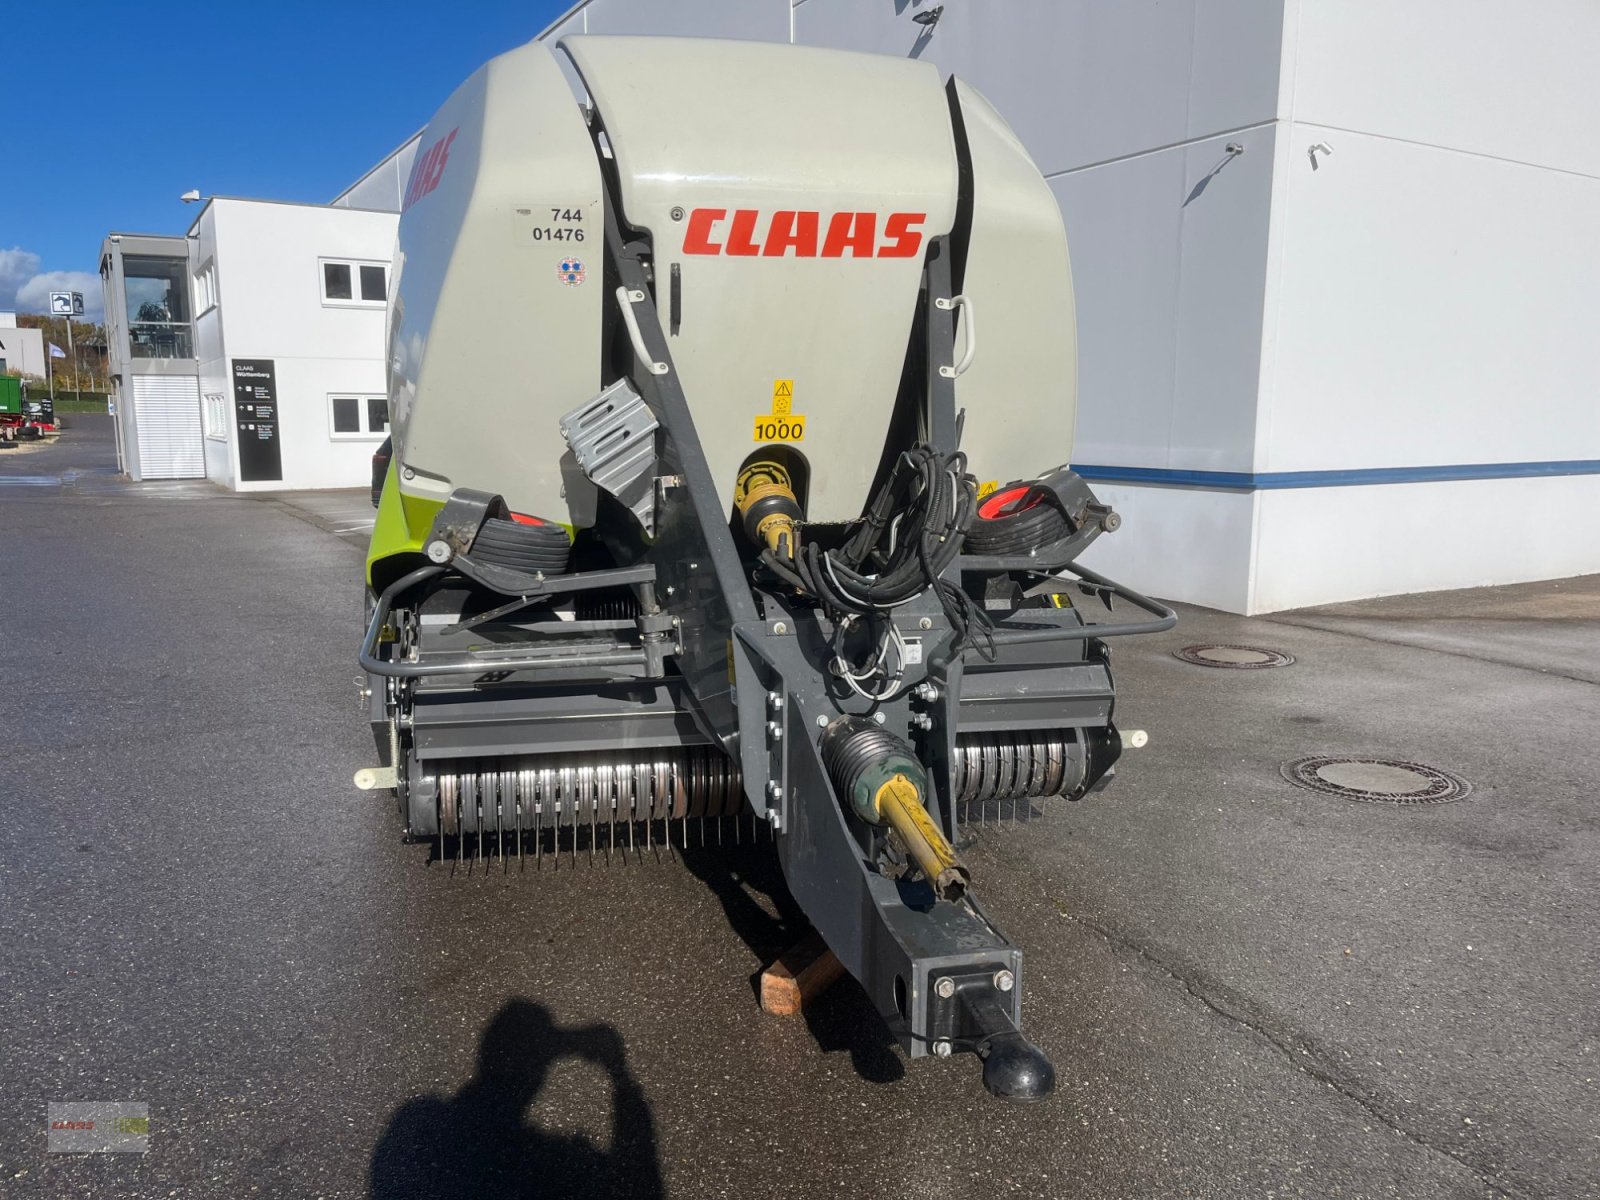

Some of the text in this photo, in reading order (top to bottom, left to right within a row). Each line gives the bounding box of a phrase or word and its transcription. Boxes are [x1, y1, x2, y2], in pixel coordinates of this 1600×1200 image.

[551, 208, 582, 222] 744
[533, 227, 585, 242] 01476
[682, 208, 927, 258] CLAAS
[756, 423, 803, 440] 1000
